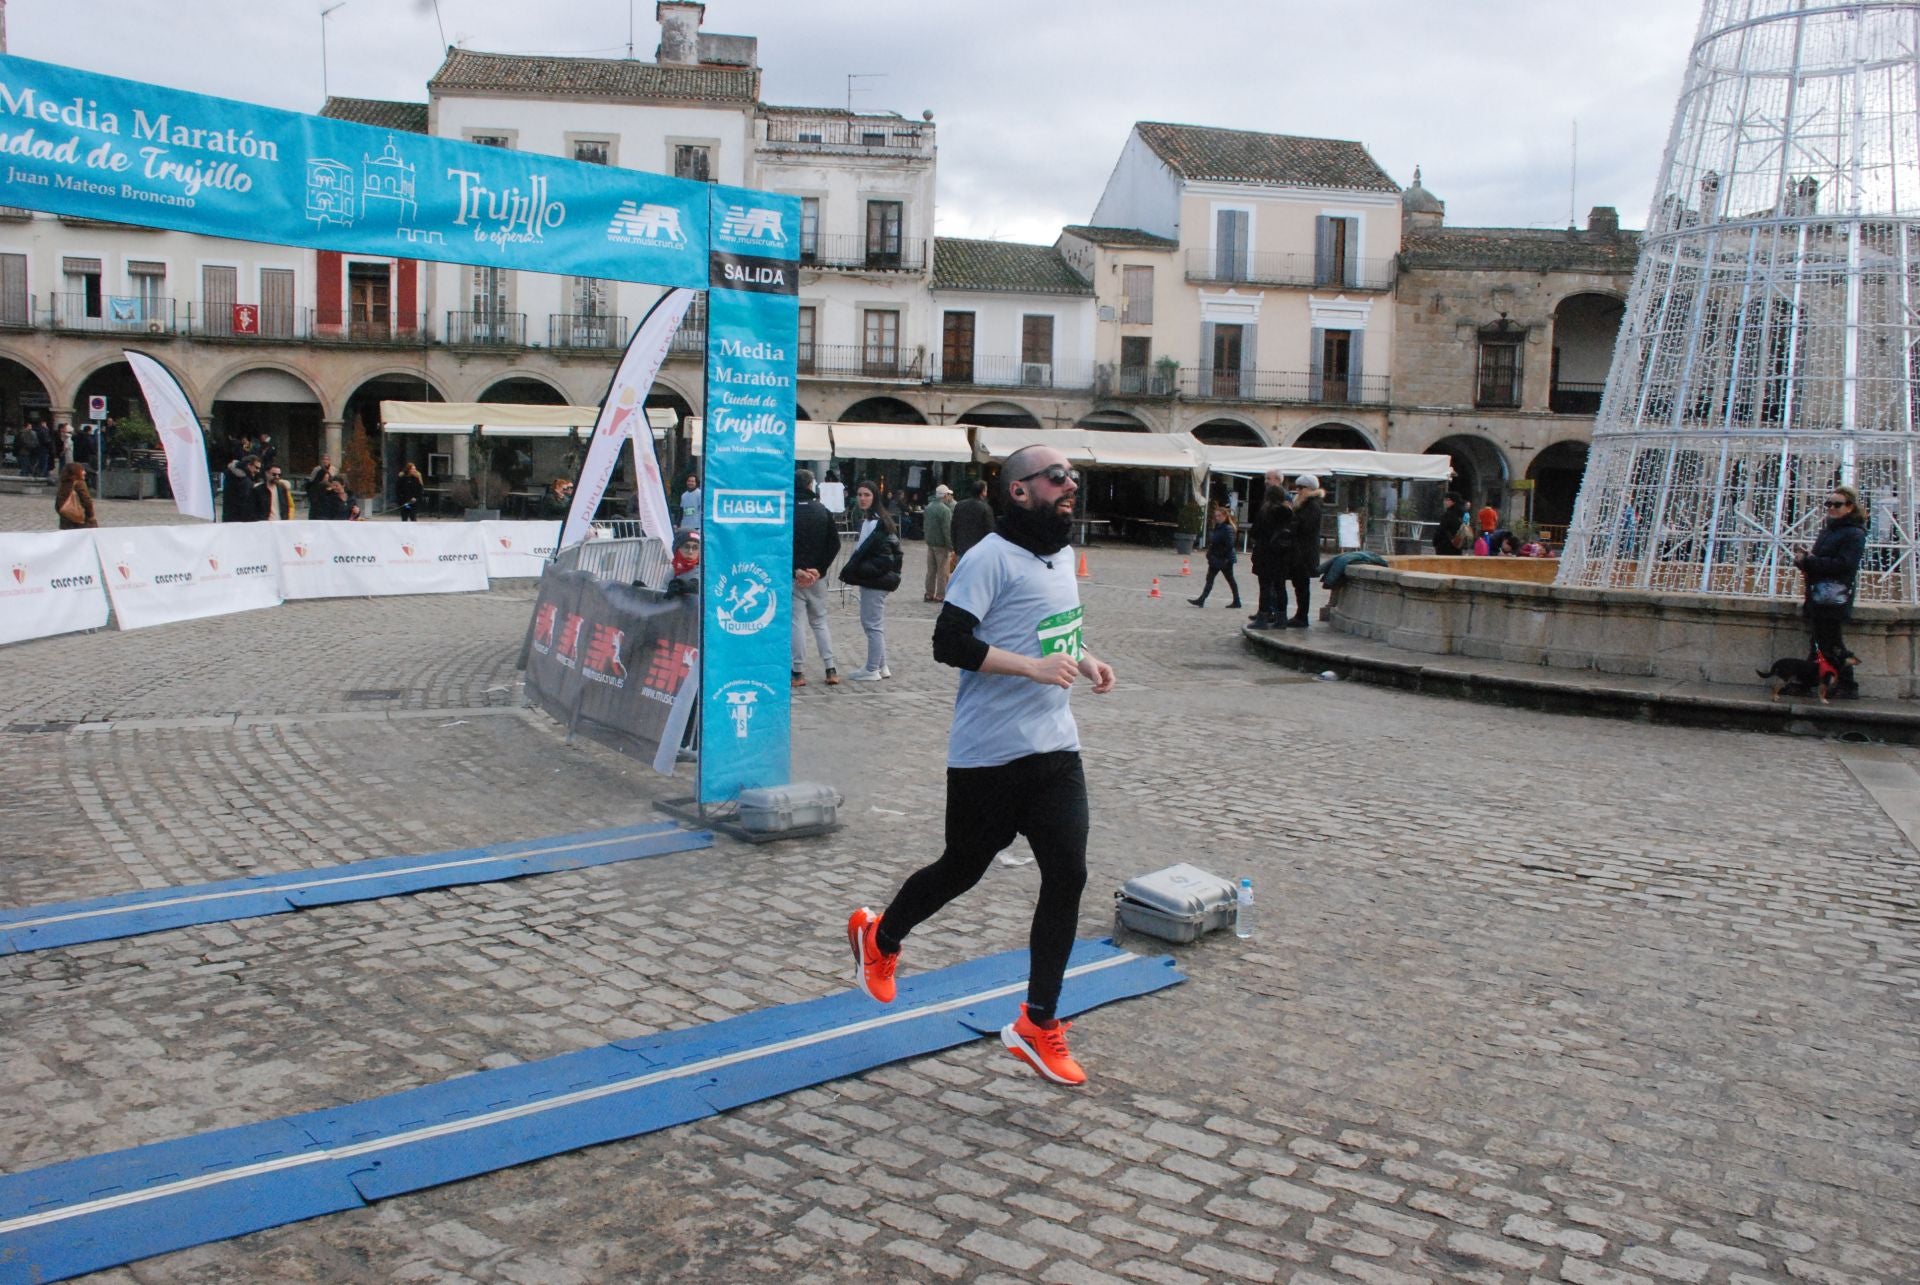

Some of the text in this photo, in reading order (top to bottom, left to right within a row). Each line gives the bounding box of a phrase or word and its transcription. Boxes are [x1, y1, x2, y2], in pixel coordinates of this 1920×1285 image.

[0, 82, 279, 162] Media Maratón
[87, 142, 133, 172] de
[139, 146, 253, 196] Trujillo
[6, 166, 196, 209] Juan Mateos Broncano
[447, 167, 566, 239] Trujillo
[474, 221, 487, 242] te
[607, 233, 685, 250] www.musicrun.es
[724, 263, 785, 286] SALIDA
[720, 339, 784, 361] Media
[714, 366, 790, 388] Maratón
[723, 391, 777, 408] Ciudad de
[712, 407, 787, 443] Trujillo
[723, 500, 775, 514] HABLA
[714, 561, 772, 597] Club Atletismo
